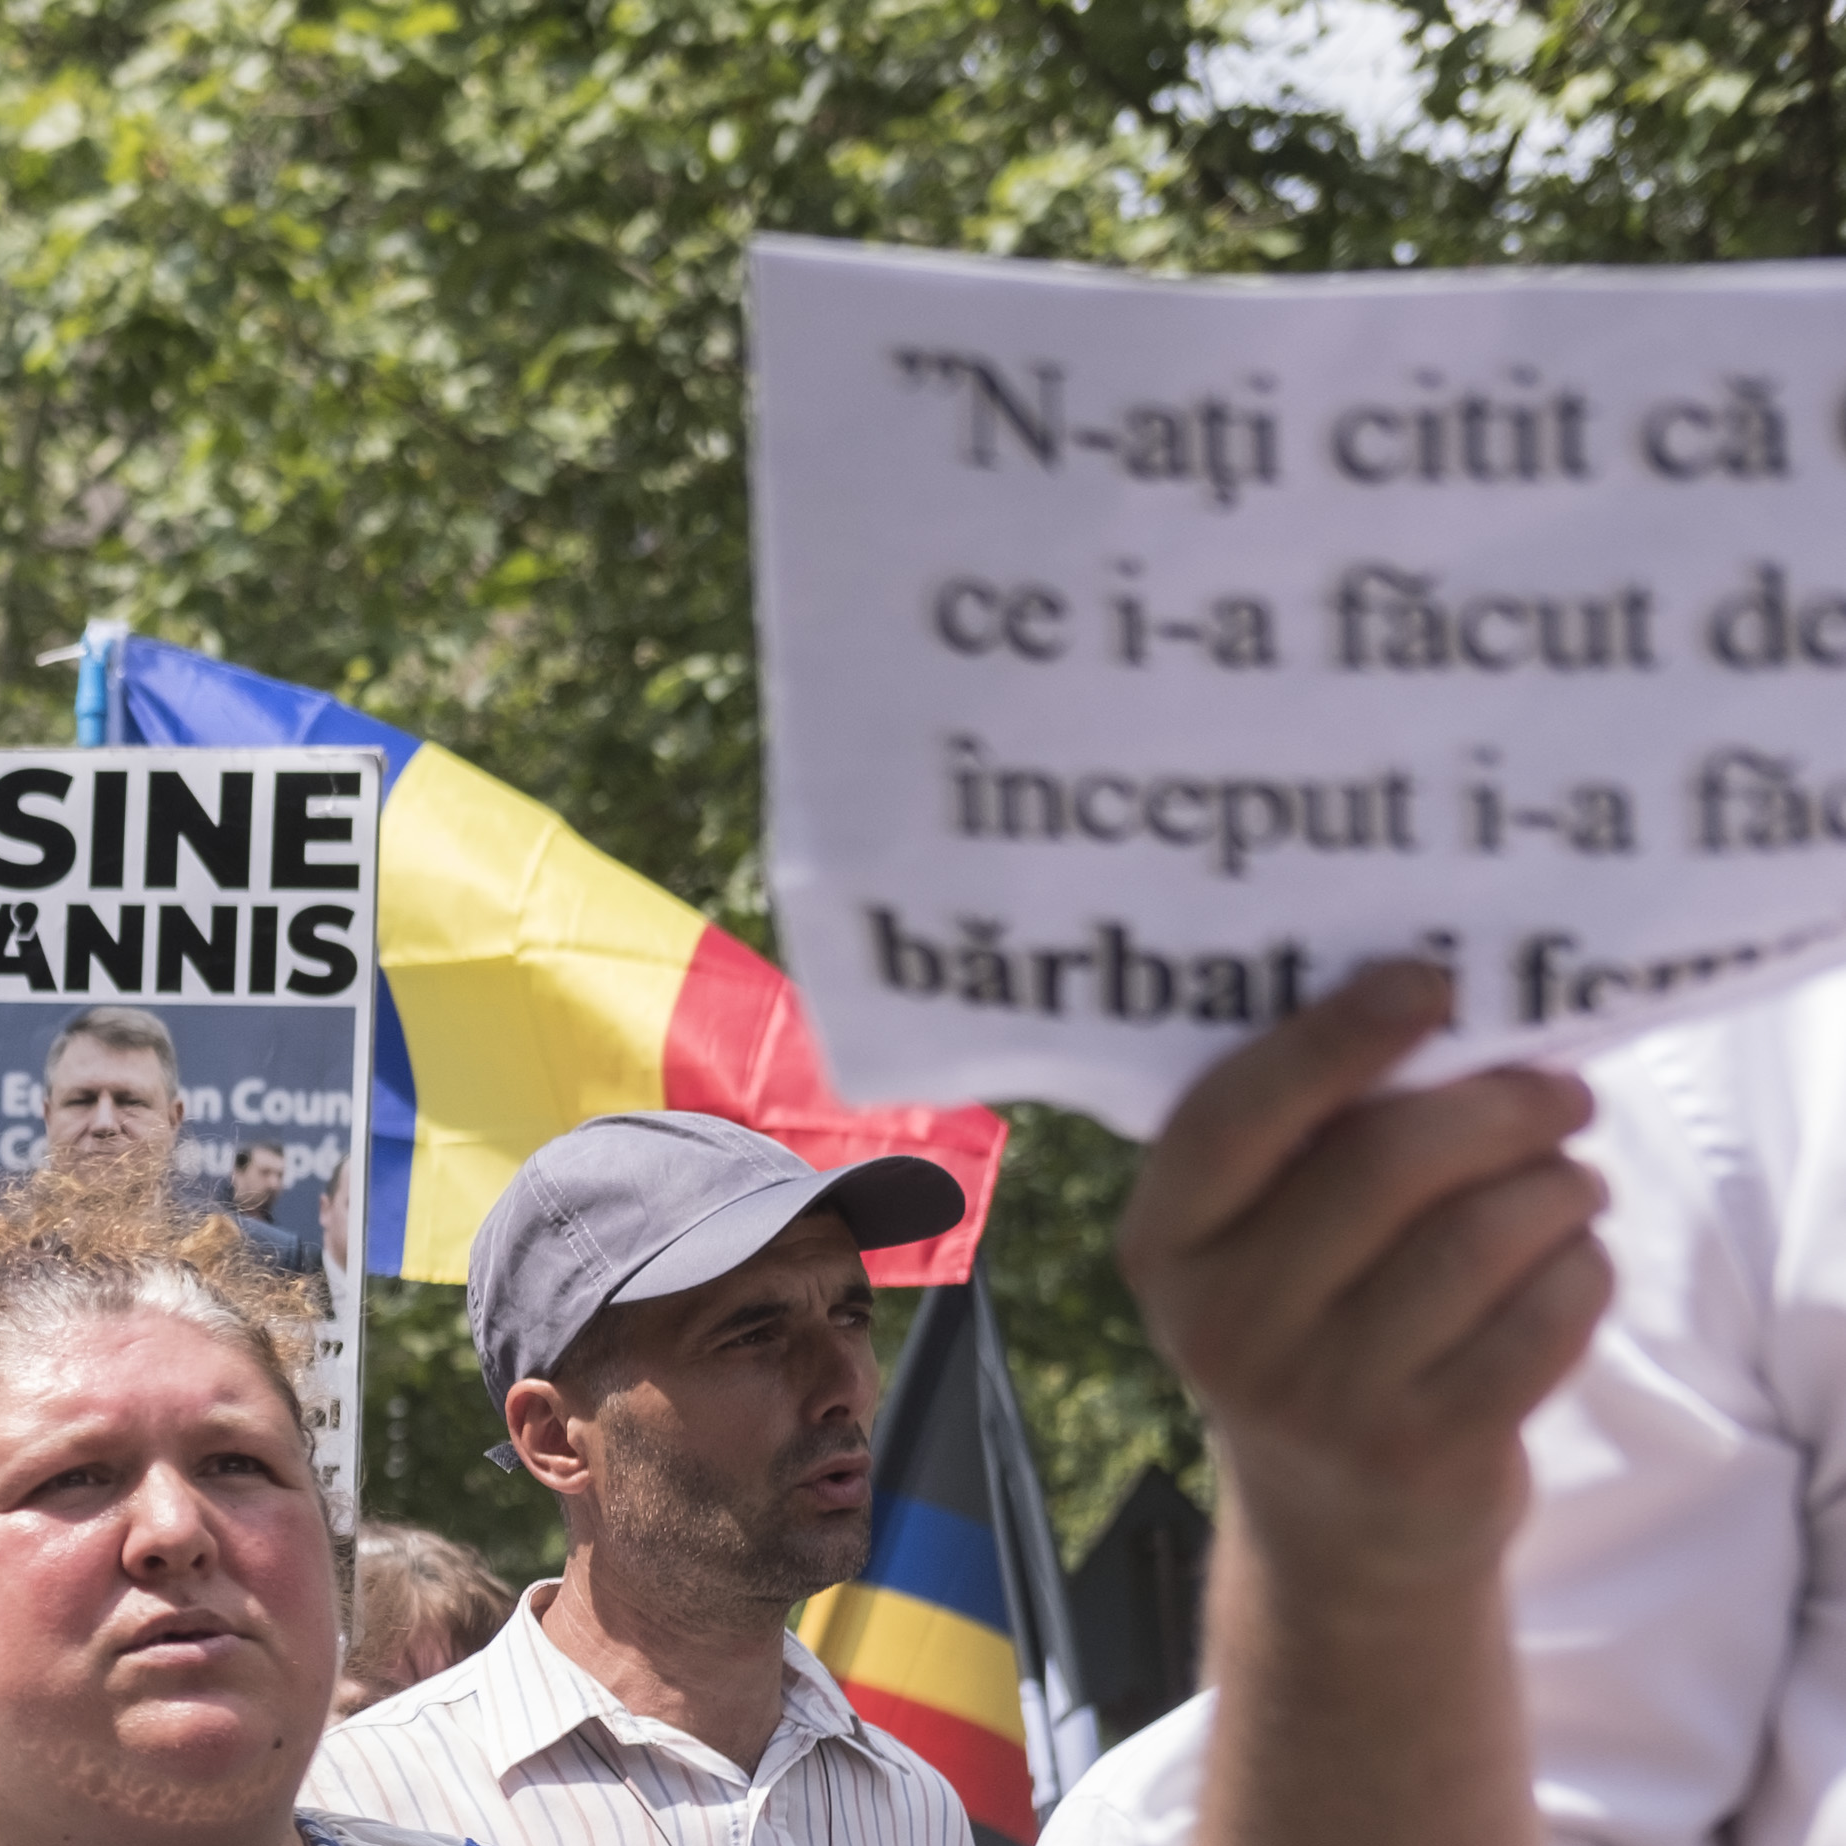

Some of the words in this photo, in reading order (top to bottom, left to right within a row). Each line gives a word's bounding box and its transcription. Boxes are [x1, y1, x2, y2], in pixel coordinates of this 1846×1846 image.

[1328, 364, 1594, 486] citit
[1636, 374, 1794, 482] că
[933, 577, 1072, 663] ce
[1112, 556, 1278, 671] i-a
[1328, 562, 1658, 672] făcut
[942, 732, 1420, 878] început
[1462, 746, 1639, 856] i-a
[864, 900, 1307, 1026] bărbat
